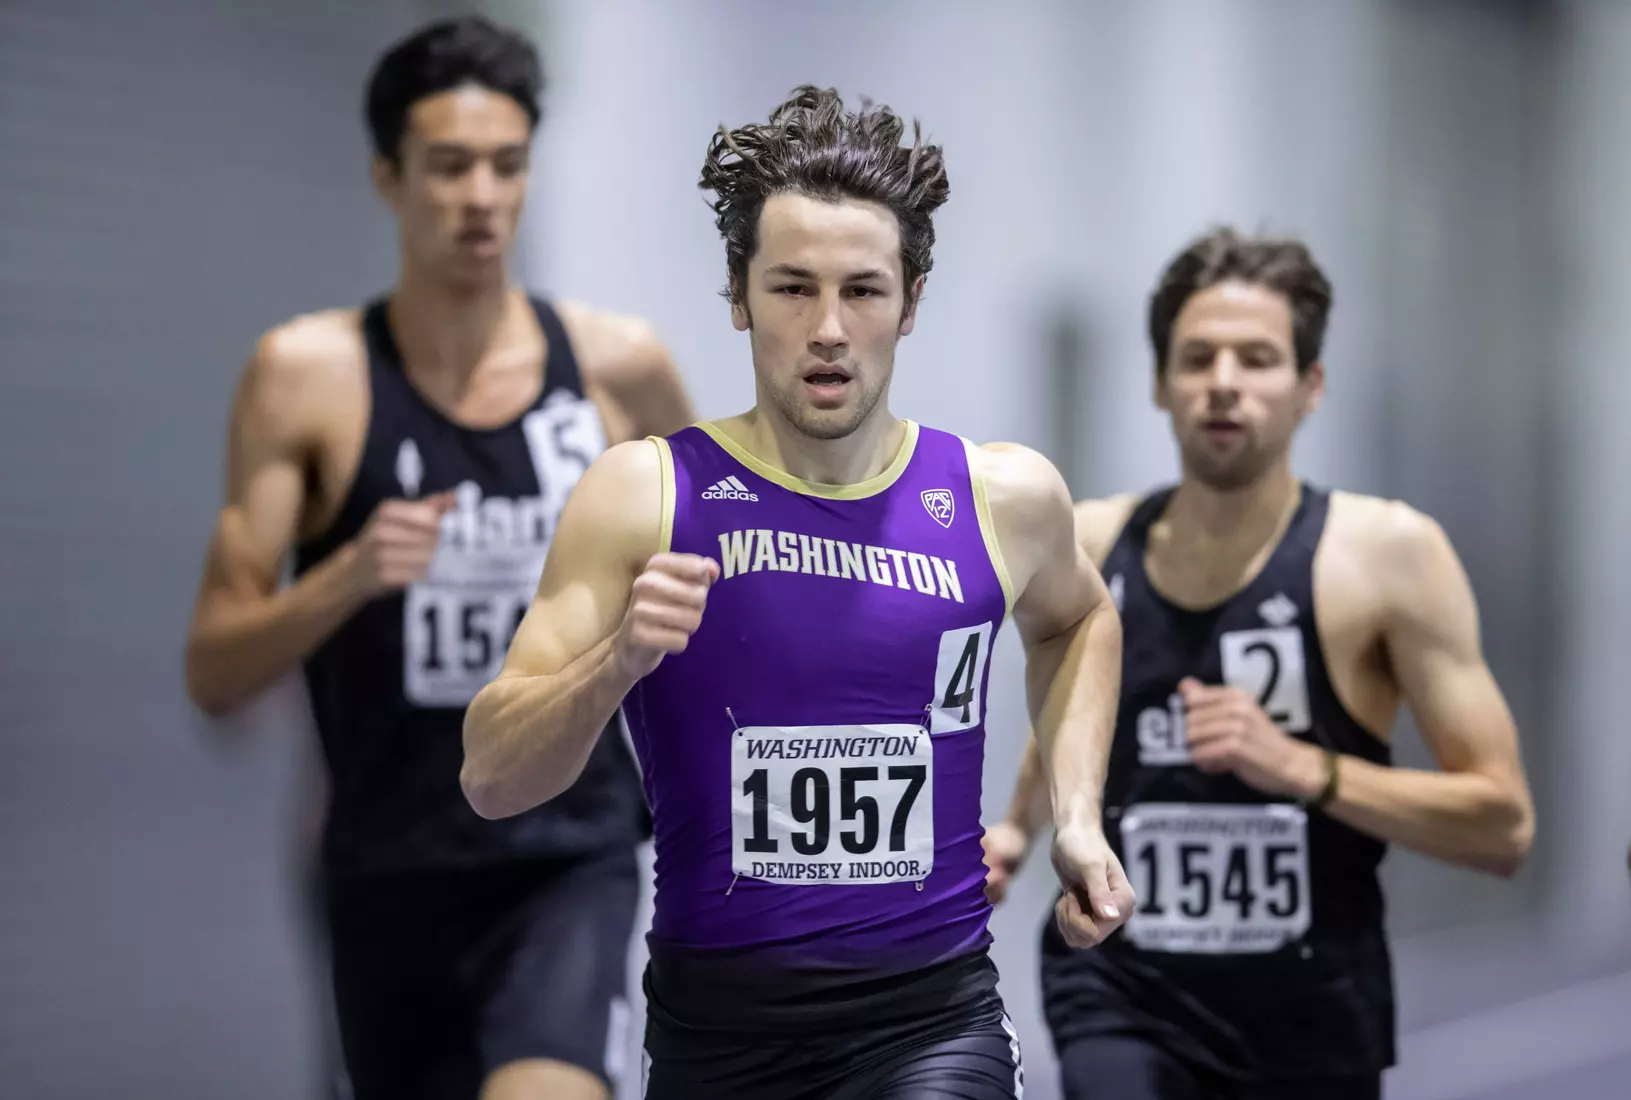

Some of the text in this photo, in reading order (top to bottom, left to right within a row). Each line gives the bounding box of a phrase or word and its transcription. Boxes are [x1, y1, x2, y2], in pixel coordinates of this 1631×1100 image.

[701, 489, 759, 502] adidas
[924, 492, 951, 511] PAC
[934, 505, 950, 519] 12
[718, 529, 965, 603] WASHINGTON
[420, 603, 528, 671] 15
[941, 632, 981, 724] 4
[1242, 641, 1290, 723] 2
[746, 736, 919, 760] WASHINGTON
[743, 764, 927, 856] 1957
[752, 860, 920, 879] DEMPSEY INDOOR
[1138, 839, 1300, 920] 1545
